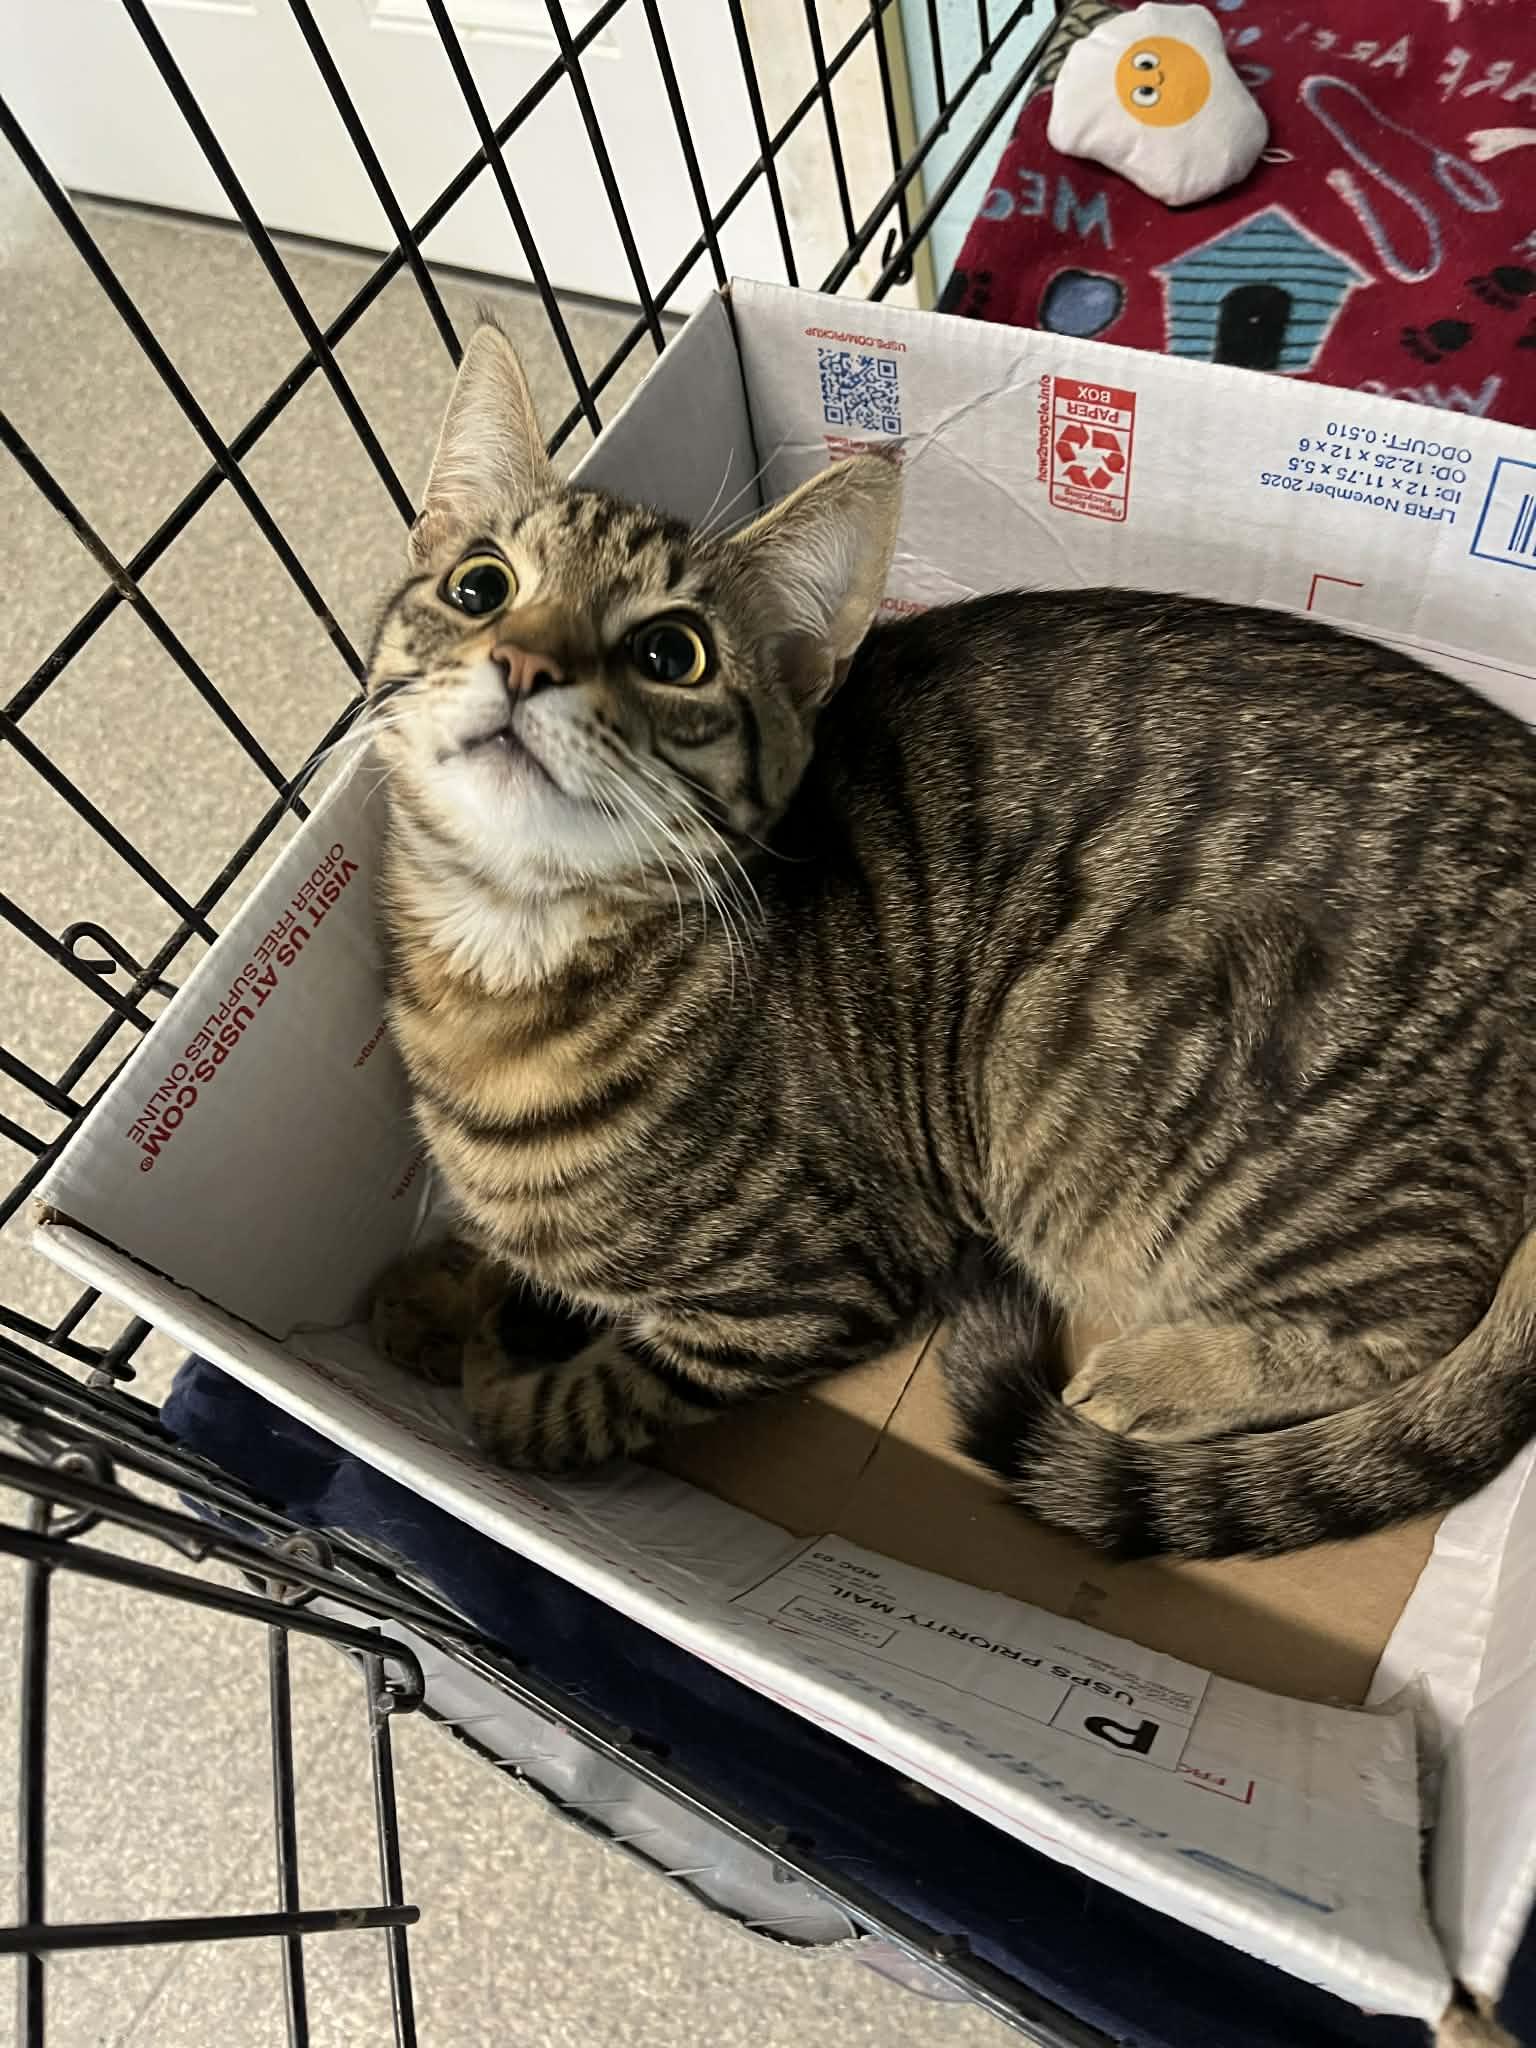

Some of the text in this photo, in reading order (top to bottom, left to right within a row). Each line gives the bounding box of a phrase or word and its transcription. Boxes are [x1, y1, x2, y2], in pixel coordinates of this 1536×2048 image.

[1066, 402, 1119, 424] PAPER
[1077, 385, 1111, 403] BOX
[1037, 374, 1051, 483] how2recycle.info
[1327, 422, 1472, 464] ODCUFT: 0.510
[1288, 457, 1462, 505] ID: 12 x 11.75 x 5.5
[1298, 438, 1467, 483] OD: 12.25 x 12 x 6
[1261, 471, 1456, 524] LFRB November 2025
[306, 859, 359, 928] VISIT
[276, 926, 311, 967] US
[127, 843, 344, 1144] ORDER FREE SUPPLIES ONLINE
[251, 964, 278, 1008] AT
[829, 1584, 896, 1614] MAIL
[899, 1614, 1042, 1667] PRIORITY
[1048, 1665, 1134, 1706] USPS
[1083, 1715, 1160, 1755] P
